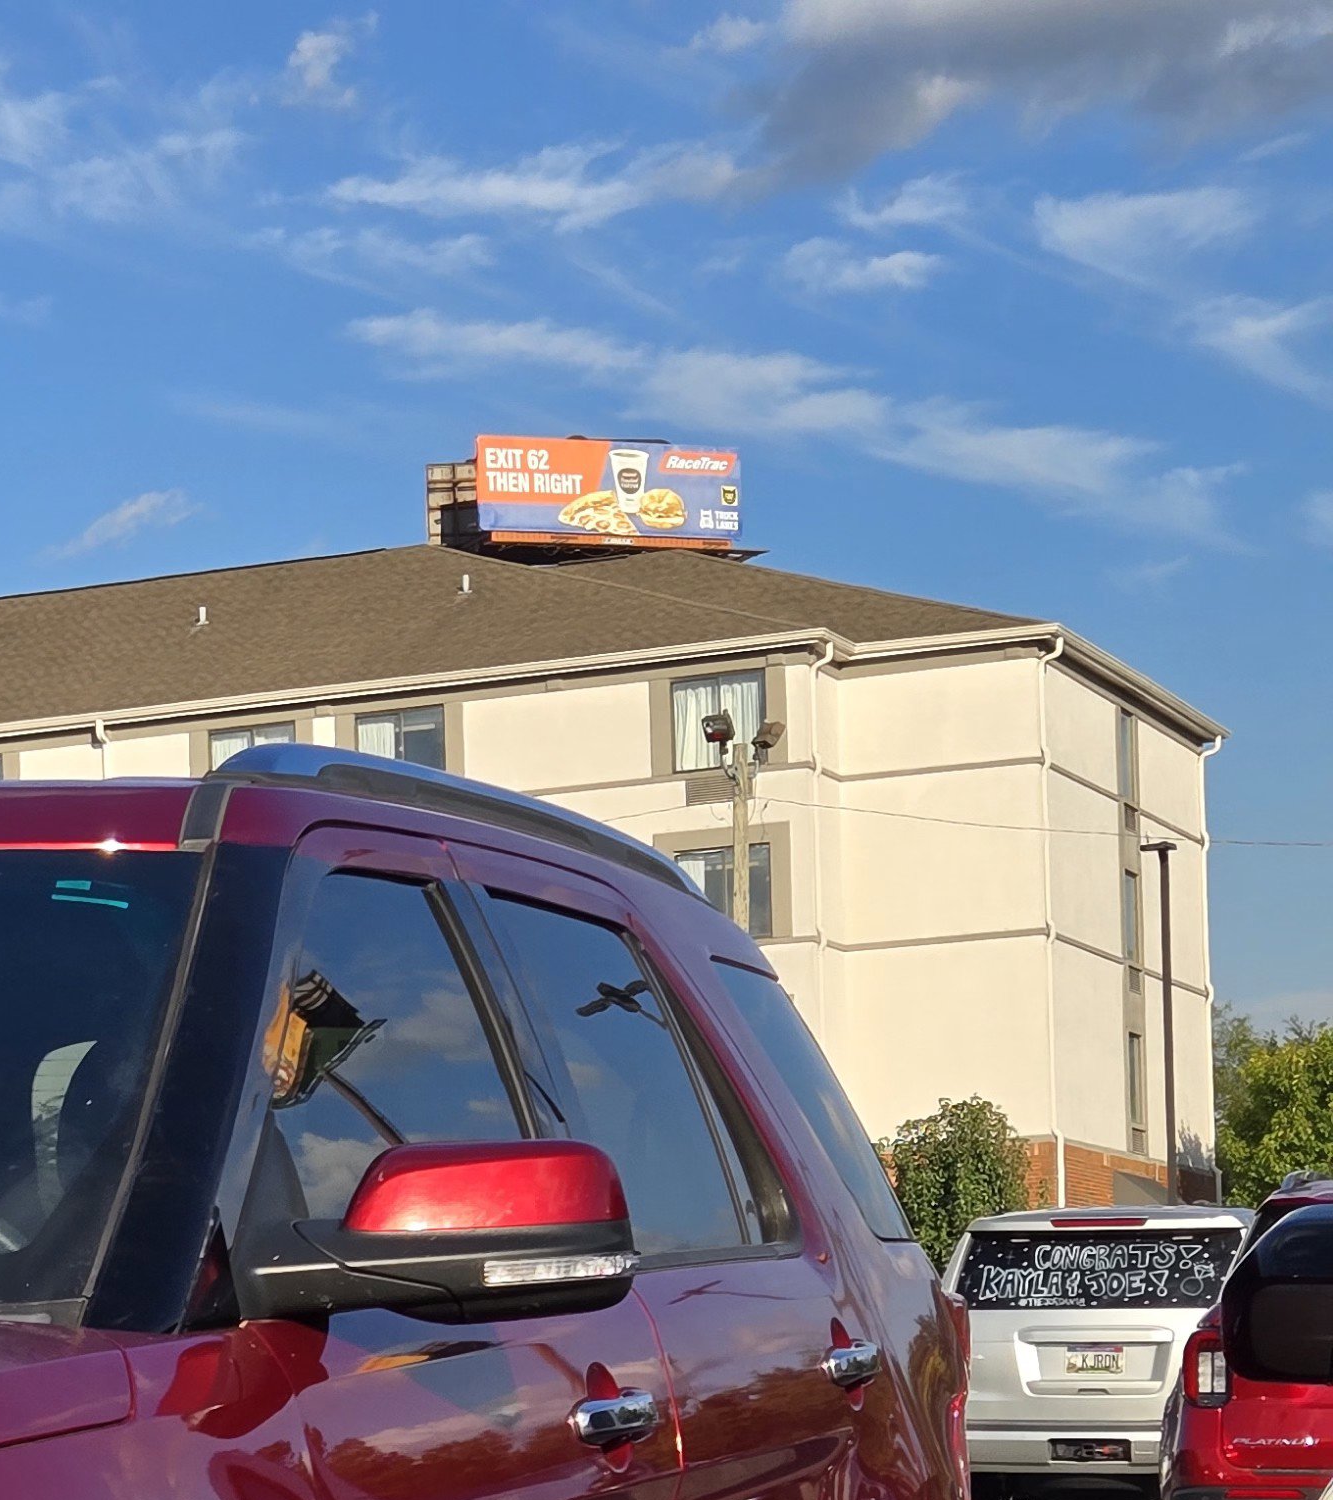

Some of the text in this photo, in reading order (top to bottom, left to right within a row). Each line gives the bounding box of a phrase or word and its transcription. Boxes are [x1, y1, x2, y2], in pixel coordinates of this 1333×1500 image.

[485, 447, 549, 470] EXIT 62
[665, 455, 728, 471] RaceTrac
[486, 471, 583, 495] THEN RIGHT
[1035, 1244, 1202, 1270] CONGRATS!
[979, 1266, 1062, 1300] KAYLA
[1085, 1270, 1169, 1297] JOE!
